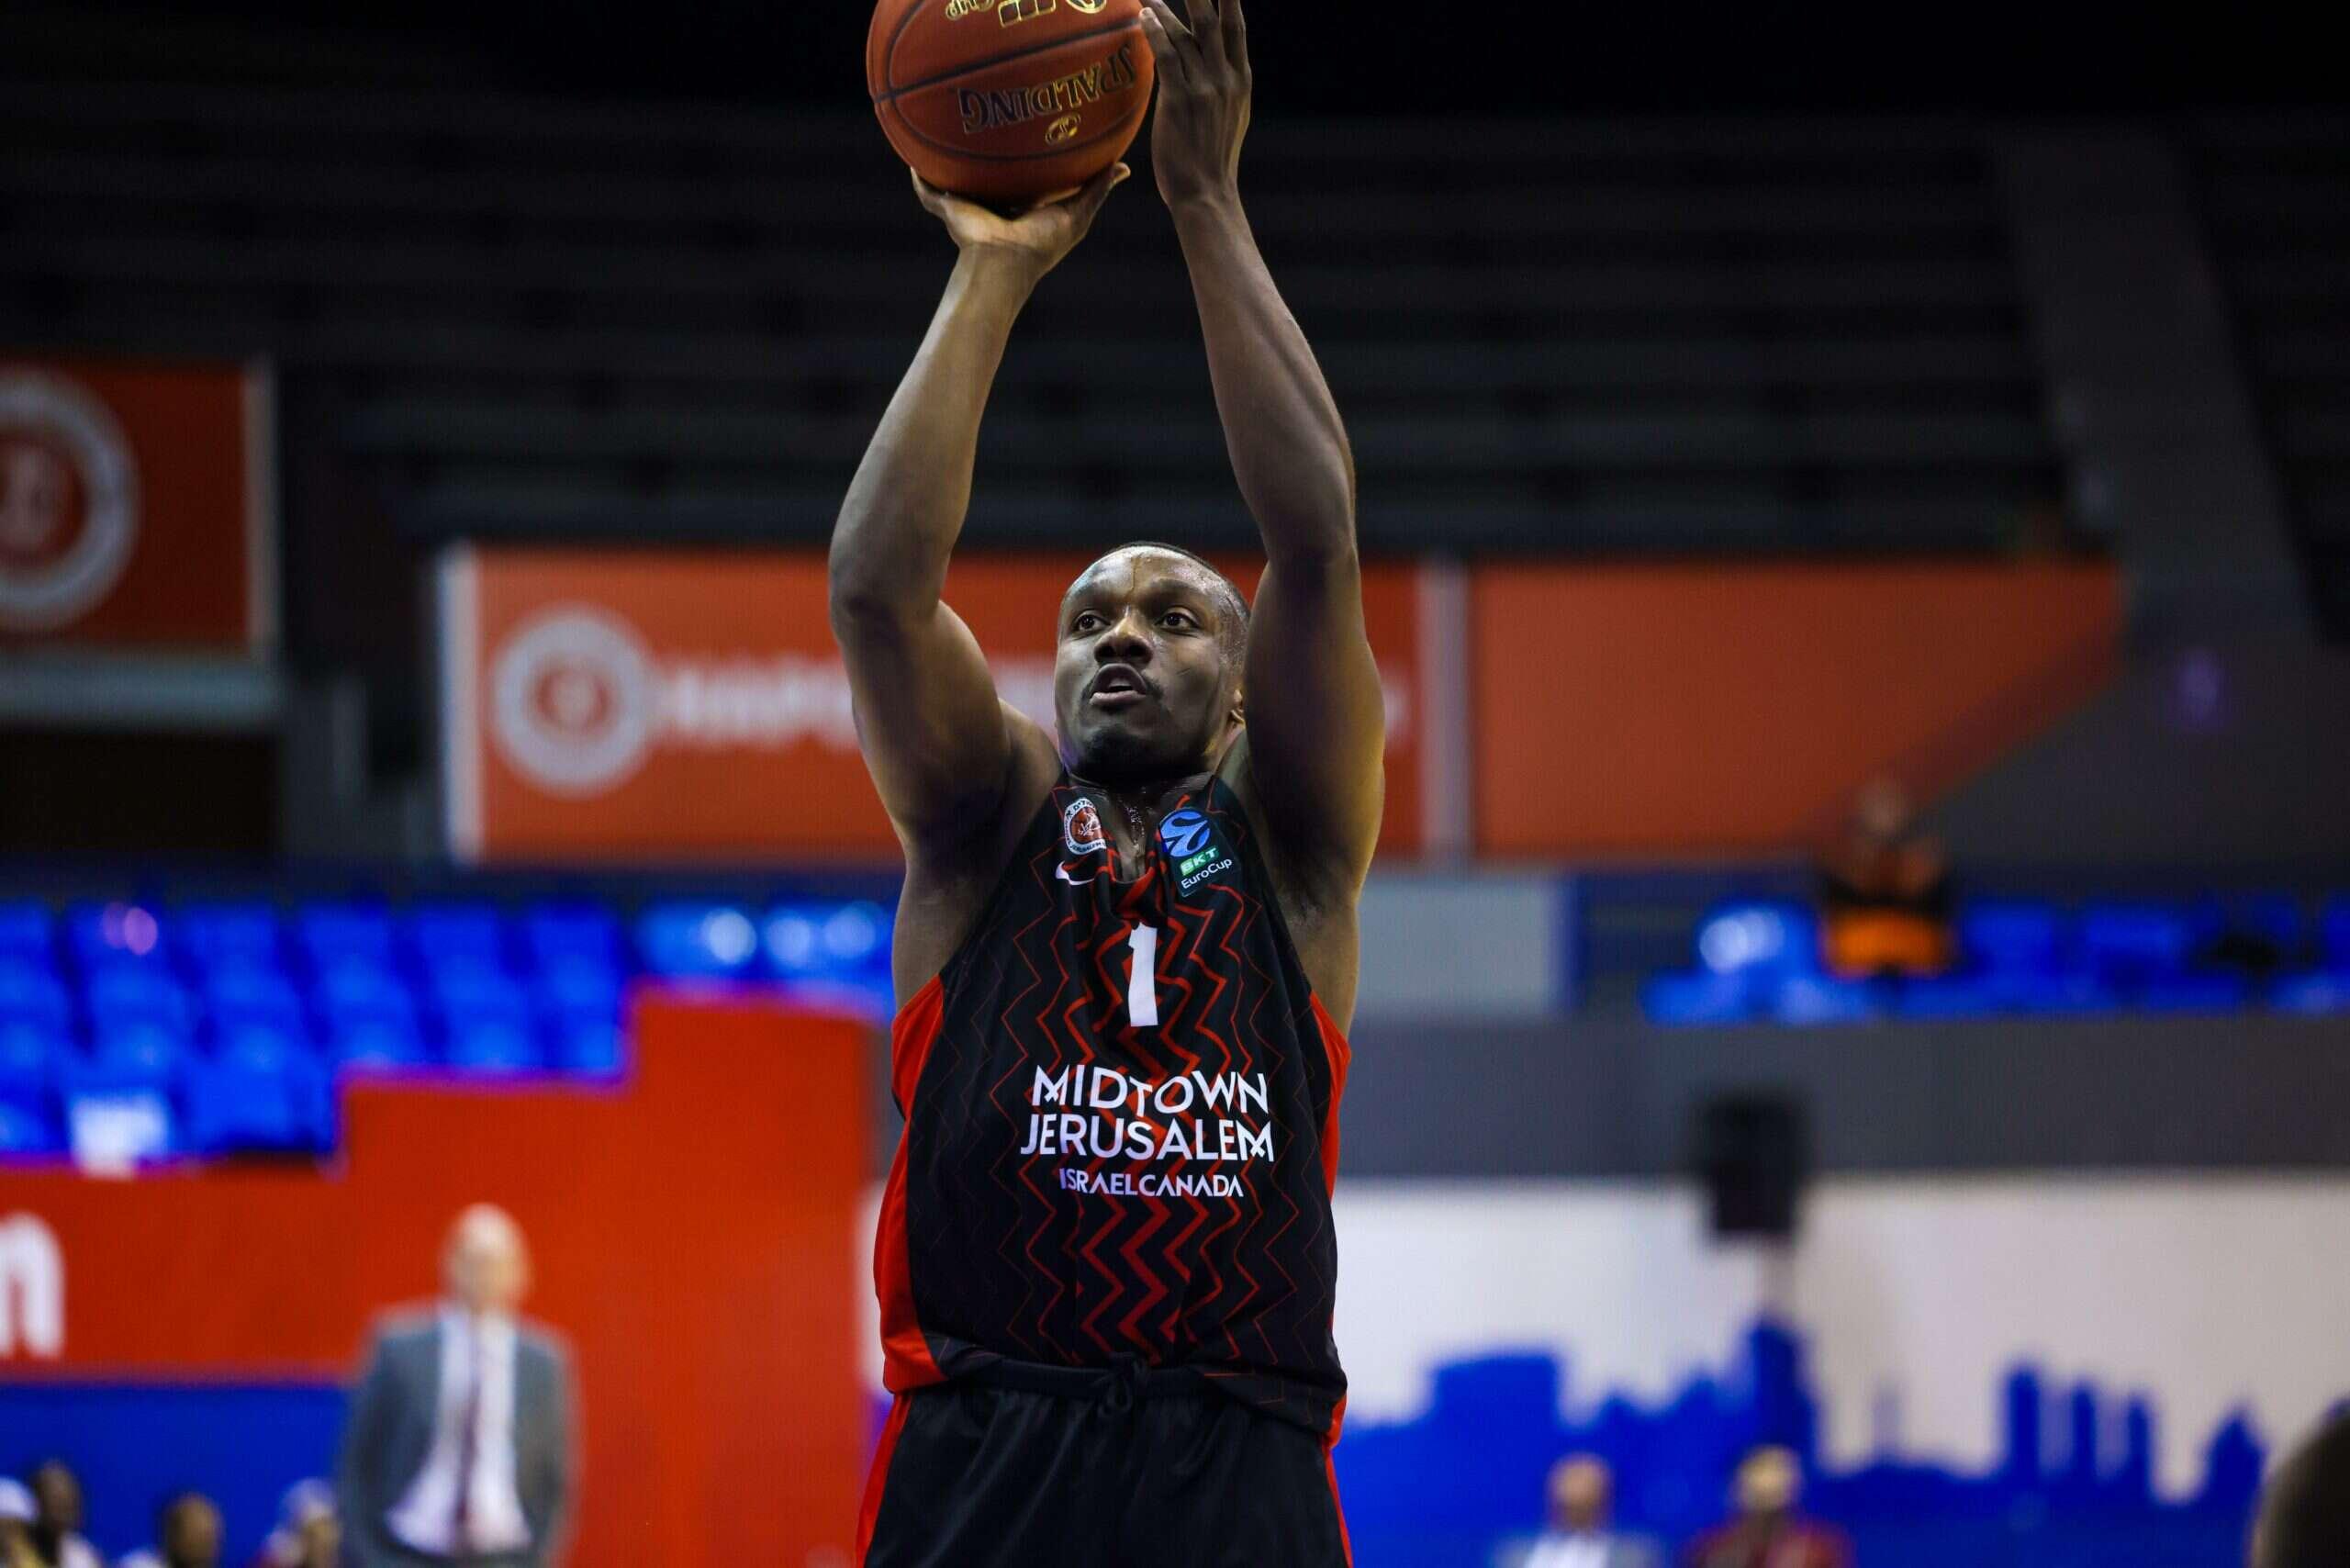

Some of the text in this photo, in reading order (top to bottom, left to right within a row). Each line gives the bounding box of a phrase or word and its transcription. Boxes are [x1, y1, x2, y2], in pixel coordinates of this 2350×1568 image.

[958, 43, 1136, 134] SPALDING
[1181, 848, 1216, 871] BKT
[1181, 858, 1232, 889] EuroCup
[1128, 922, 1158, 1027] 1
[1031, 1064, 1270, 1117] MIDTOWN
[1020, 1113, 1274, 1162] JERUSALEM
